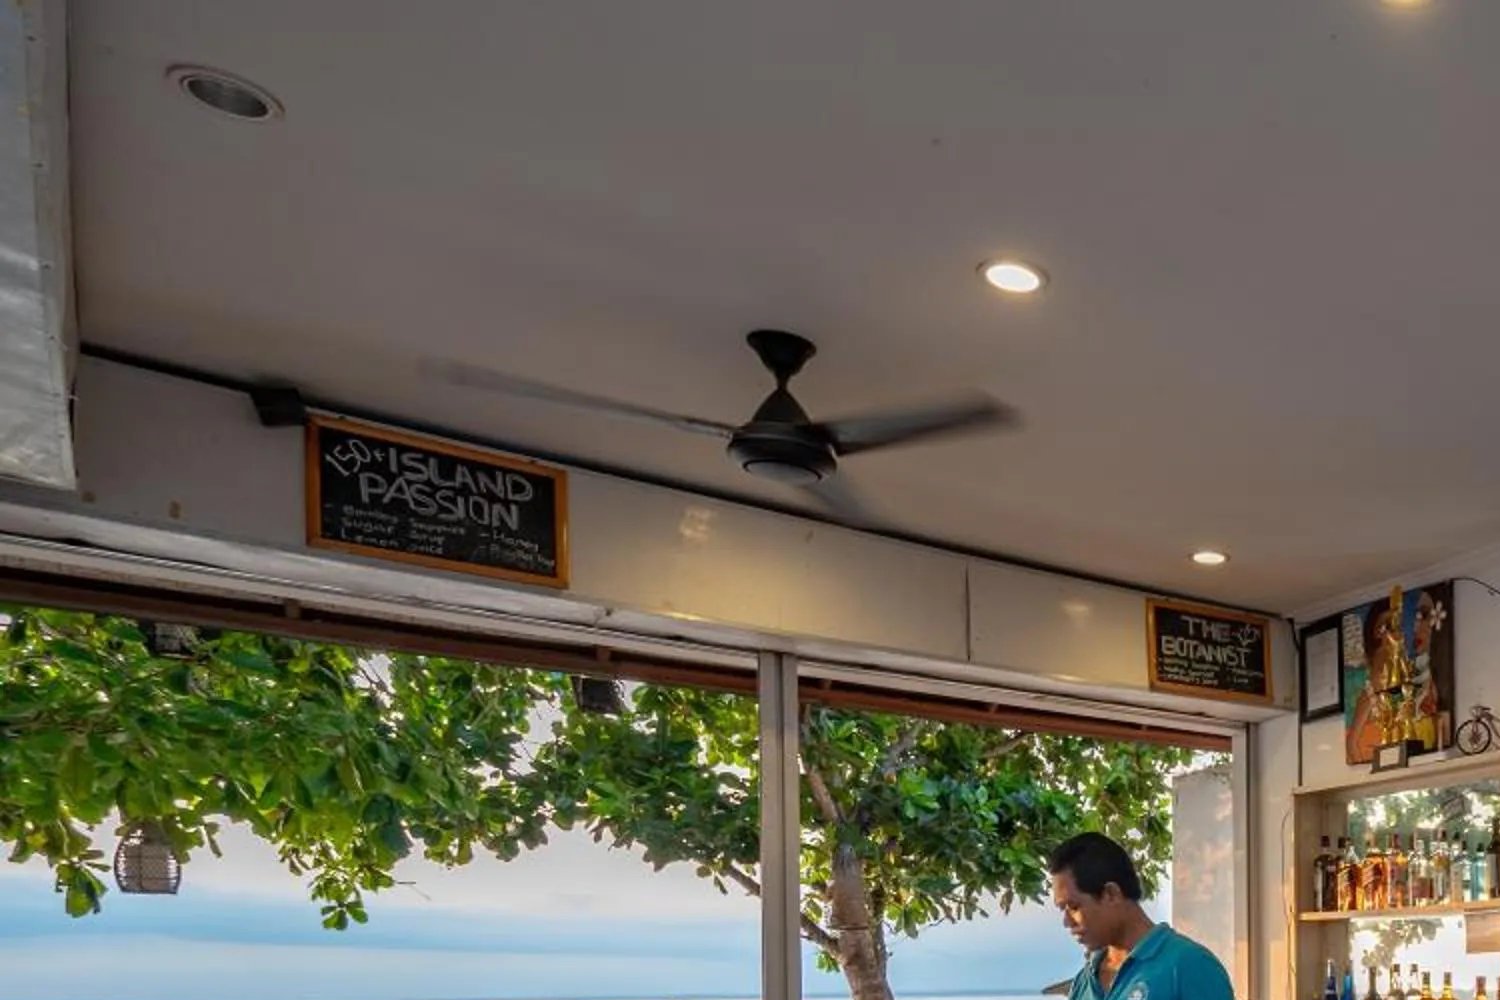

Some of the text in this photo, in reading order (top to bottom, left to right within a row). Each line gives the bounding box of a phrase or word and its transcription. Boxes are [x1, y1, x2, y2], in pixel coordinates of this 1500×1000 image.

[388, 447, 533, 501] ISLAND
[359, 472, 519, 531] PASSION
[1181, 615, 1232, 642] THE
[1161, 635, 1252, 668] BOTANIST
